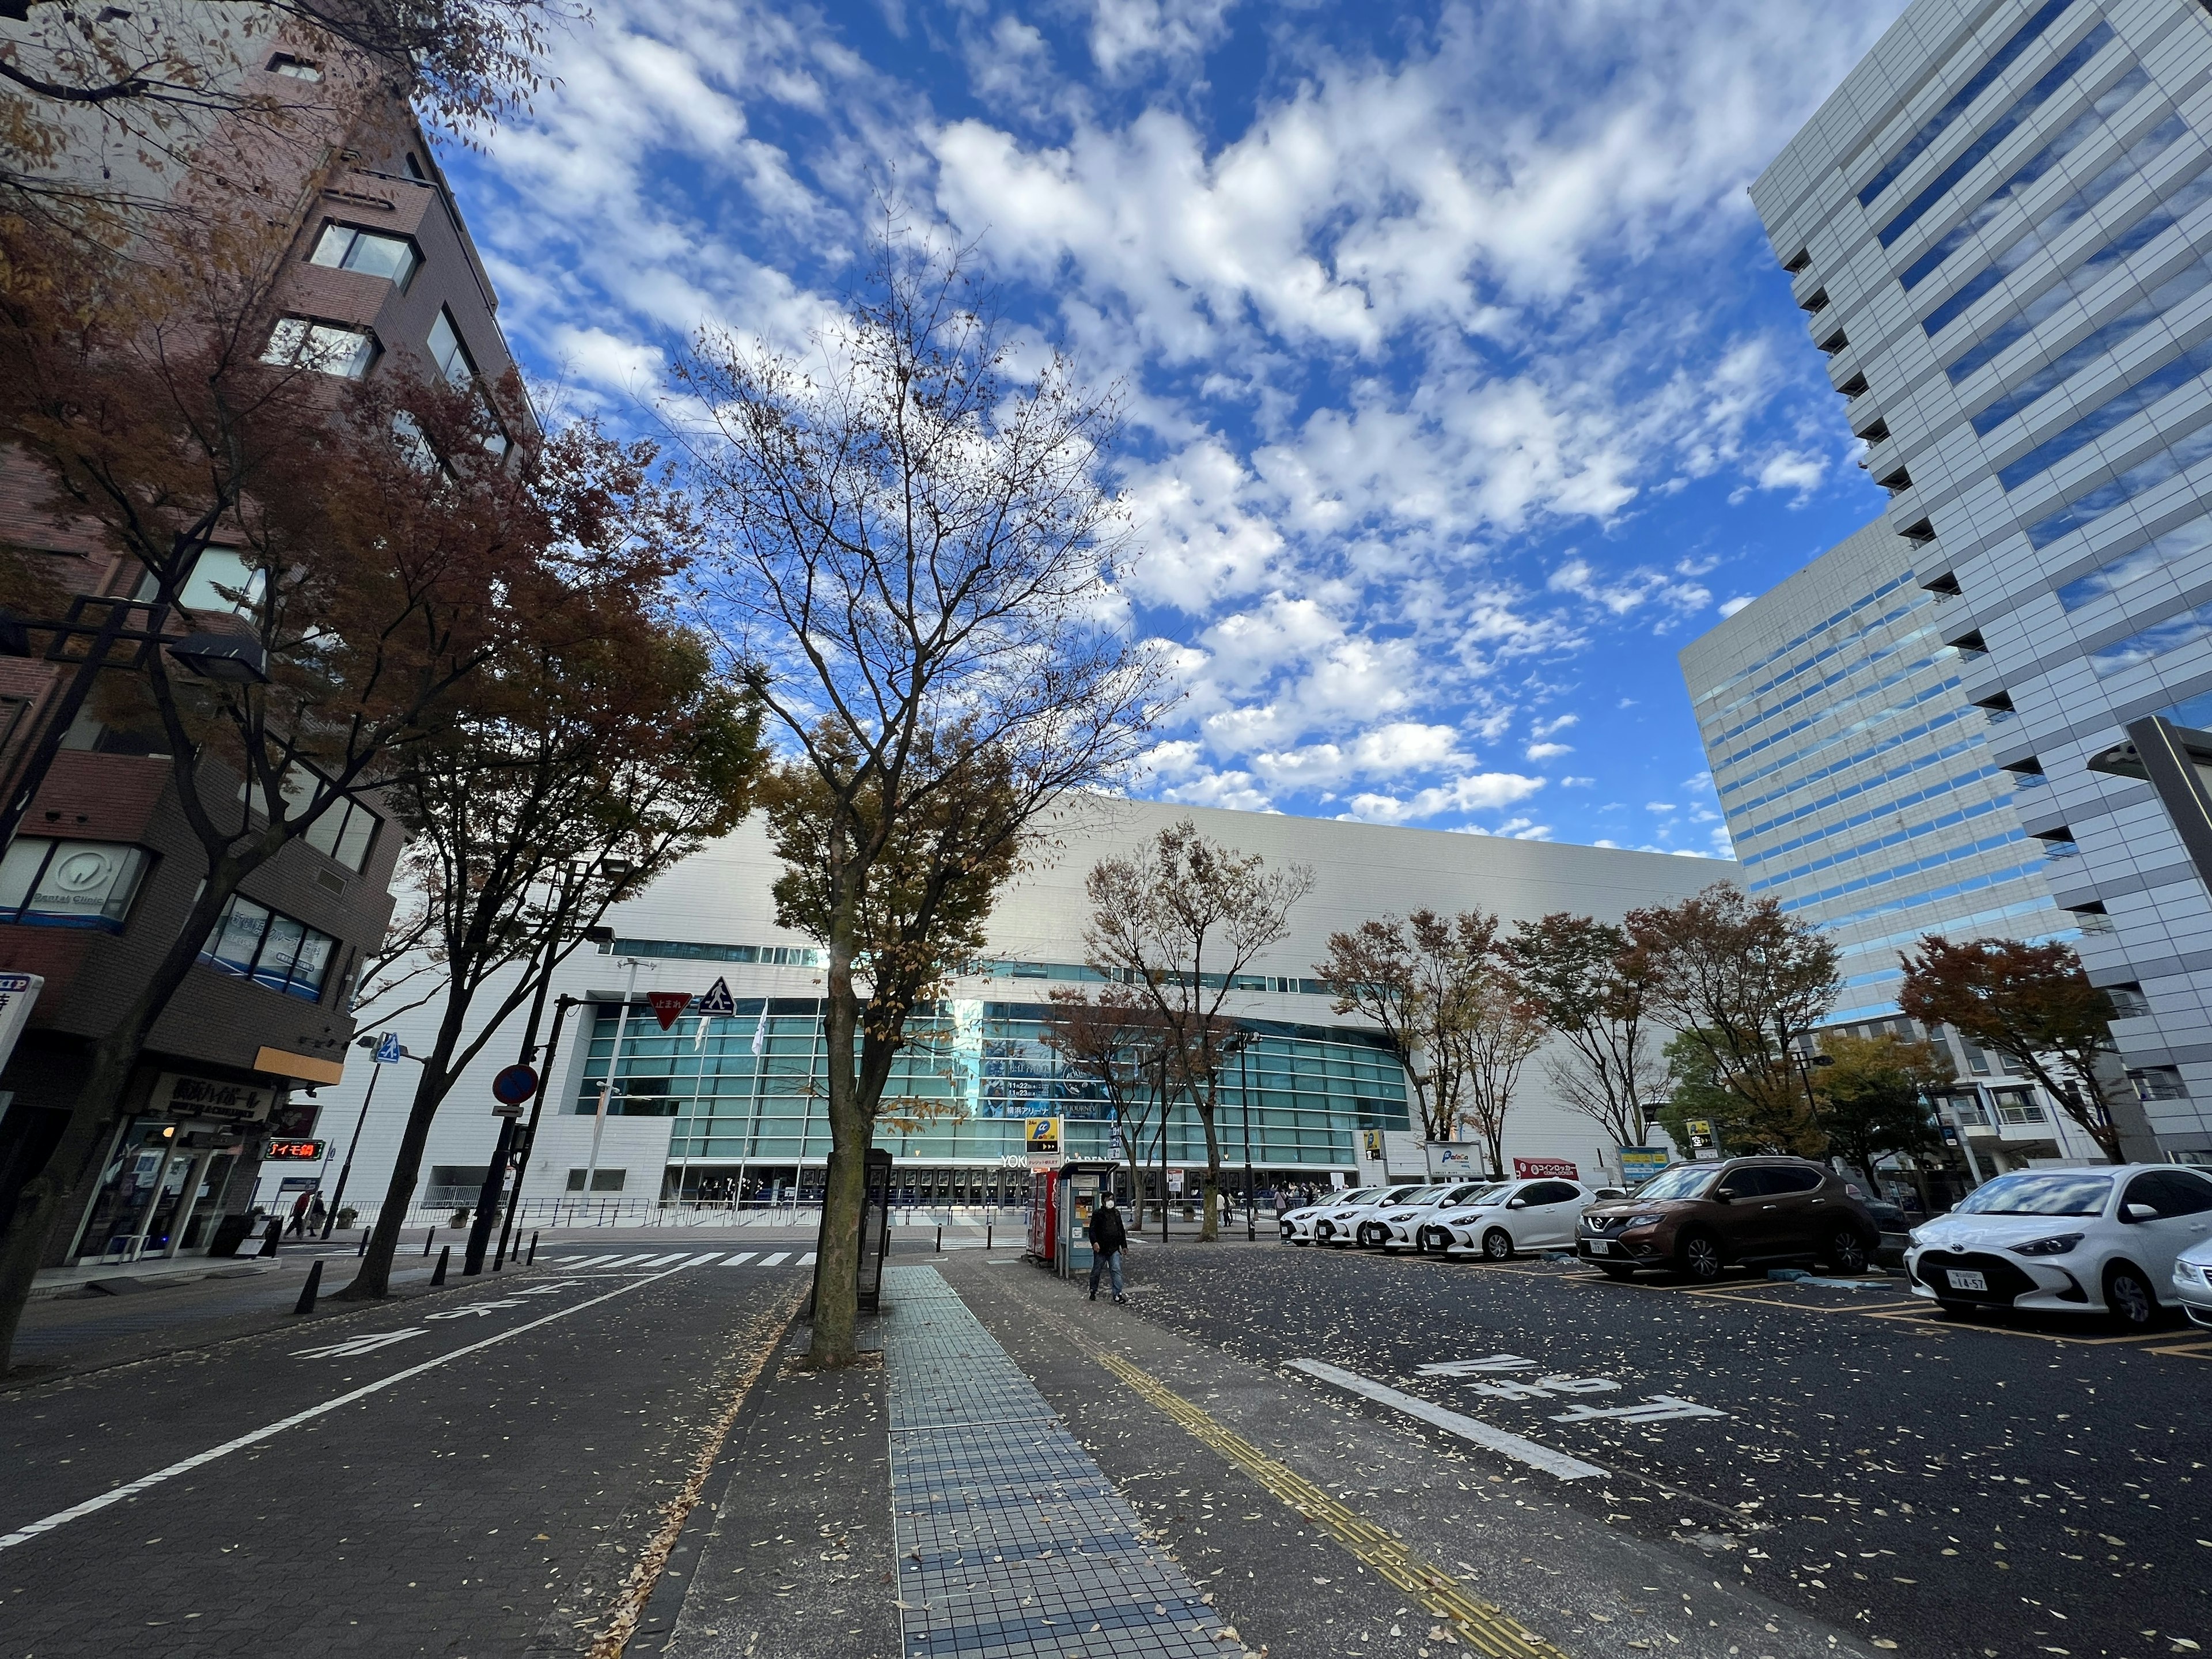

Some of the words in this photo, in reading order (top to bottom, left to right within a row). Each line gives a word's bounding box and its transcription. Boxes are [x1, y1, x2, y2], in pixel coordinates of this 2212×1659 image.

[34, 893, 69, 903] Dental
[73, 895, 104, 904] Clinic
[655, 999, 681, 1009] 止まれ
[1007, 1107, 1048, 1115] 横浜アリーナ
[1957, 1278, 1983, 1289] 14-57
